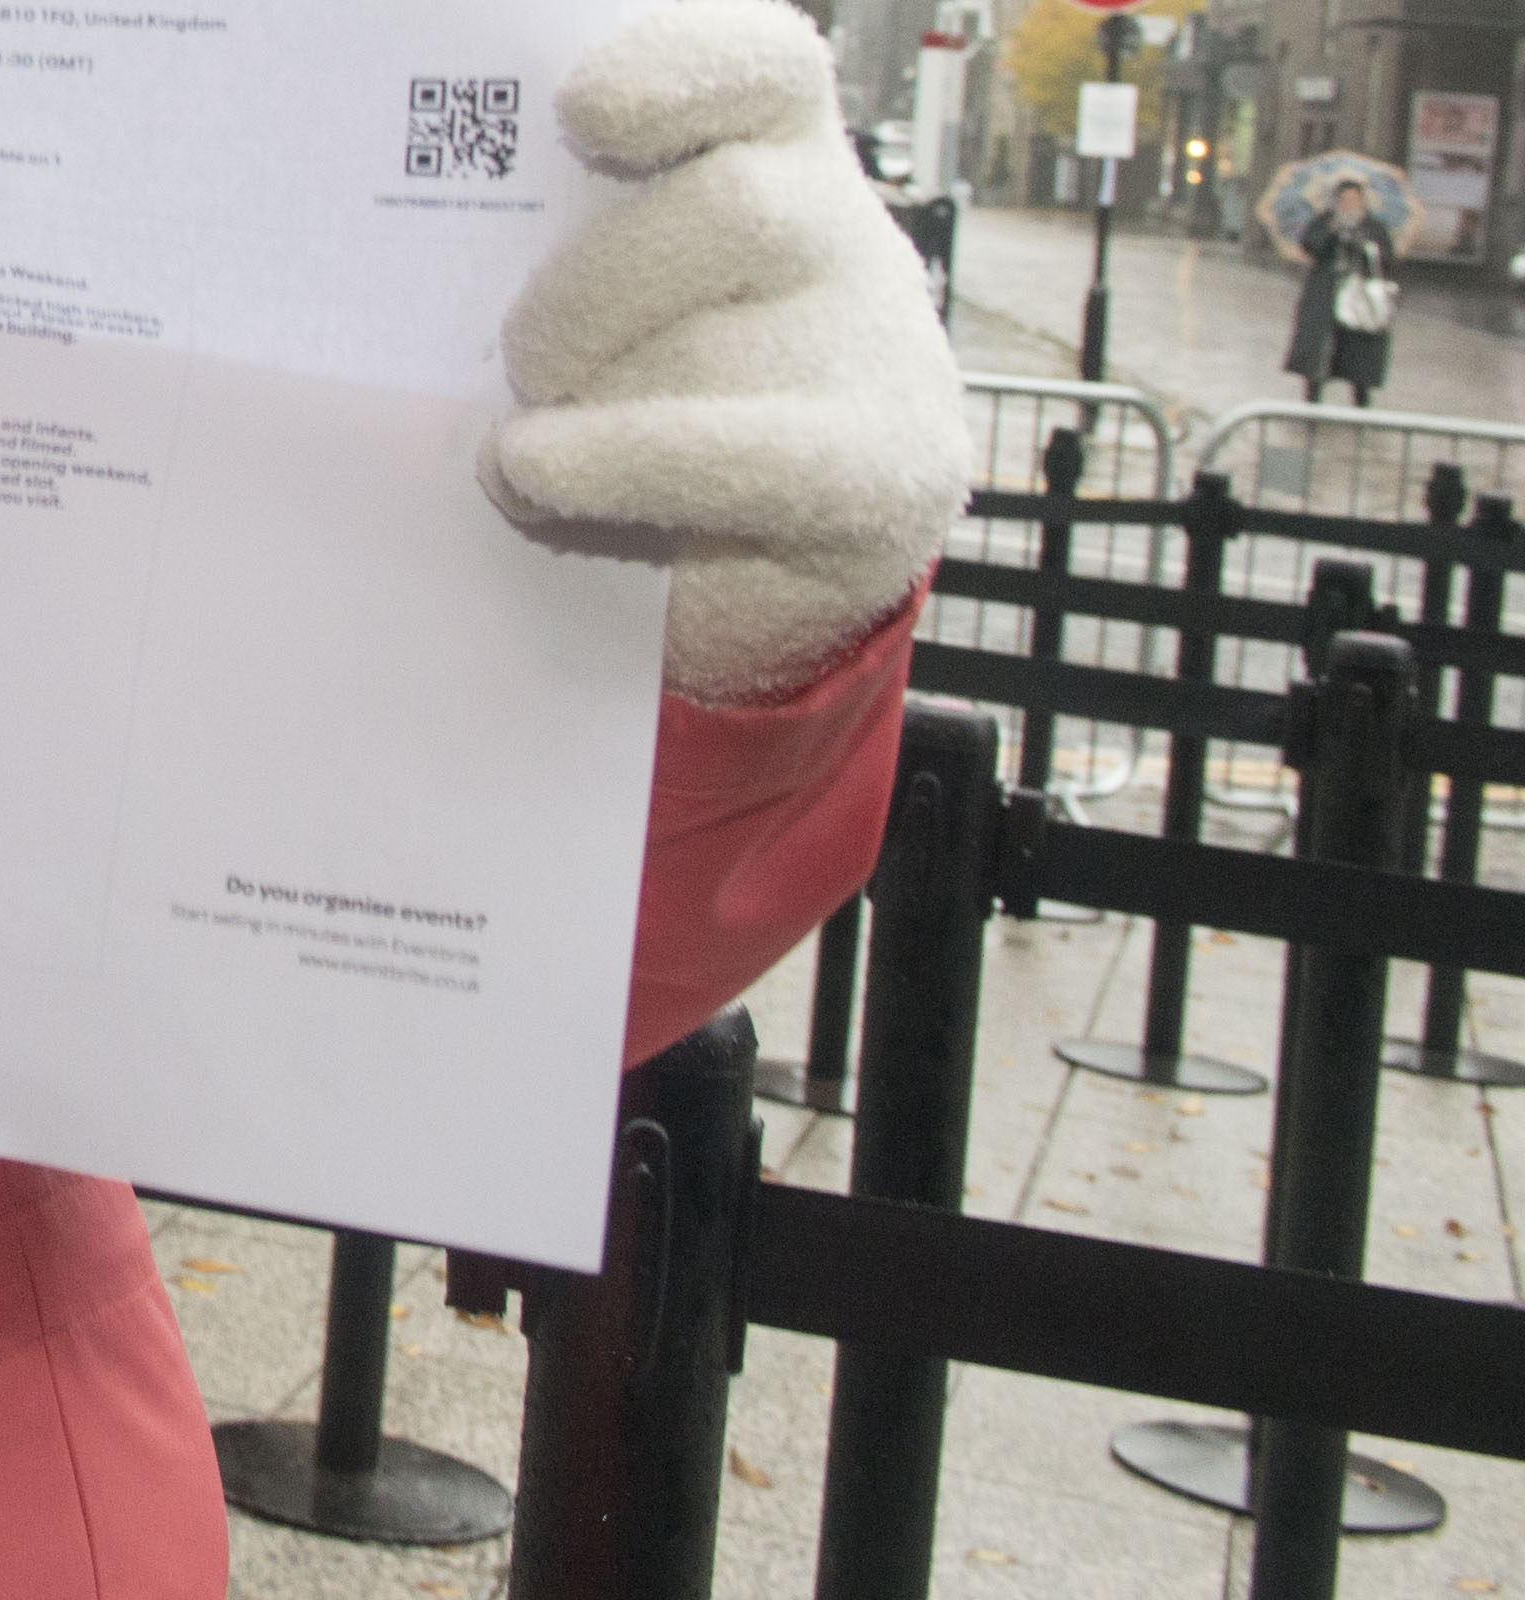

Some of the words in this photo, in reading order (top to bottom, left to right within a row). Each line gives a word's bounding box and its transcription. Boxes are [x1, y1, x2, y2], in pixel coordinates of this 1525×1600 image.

[84, 12, 143, 28] United
[146, 14, 227, 33] Kingdom
[1, 420, 32, 435] and
[0, 458, 67, 476] opening
[226, 875, 255, 896] Do
[259, 885, 298, 903] you
[302, 892, 395, 917] organise
[400, 907, 489, 930] events?
